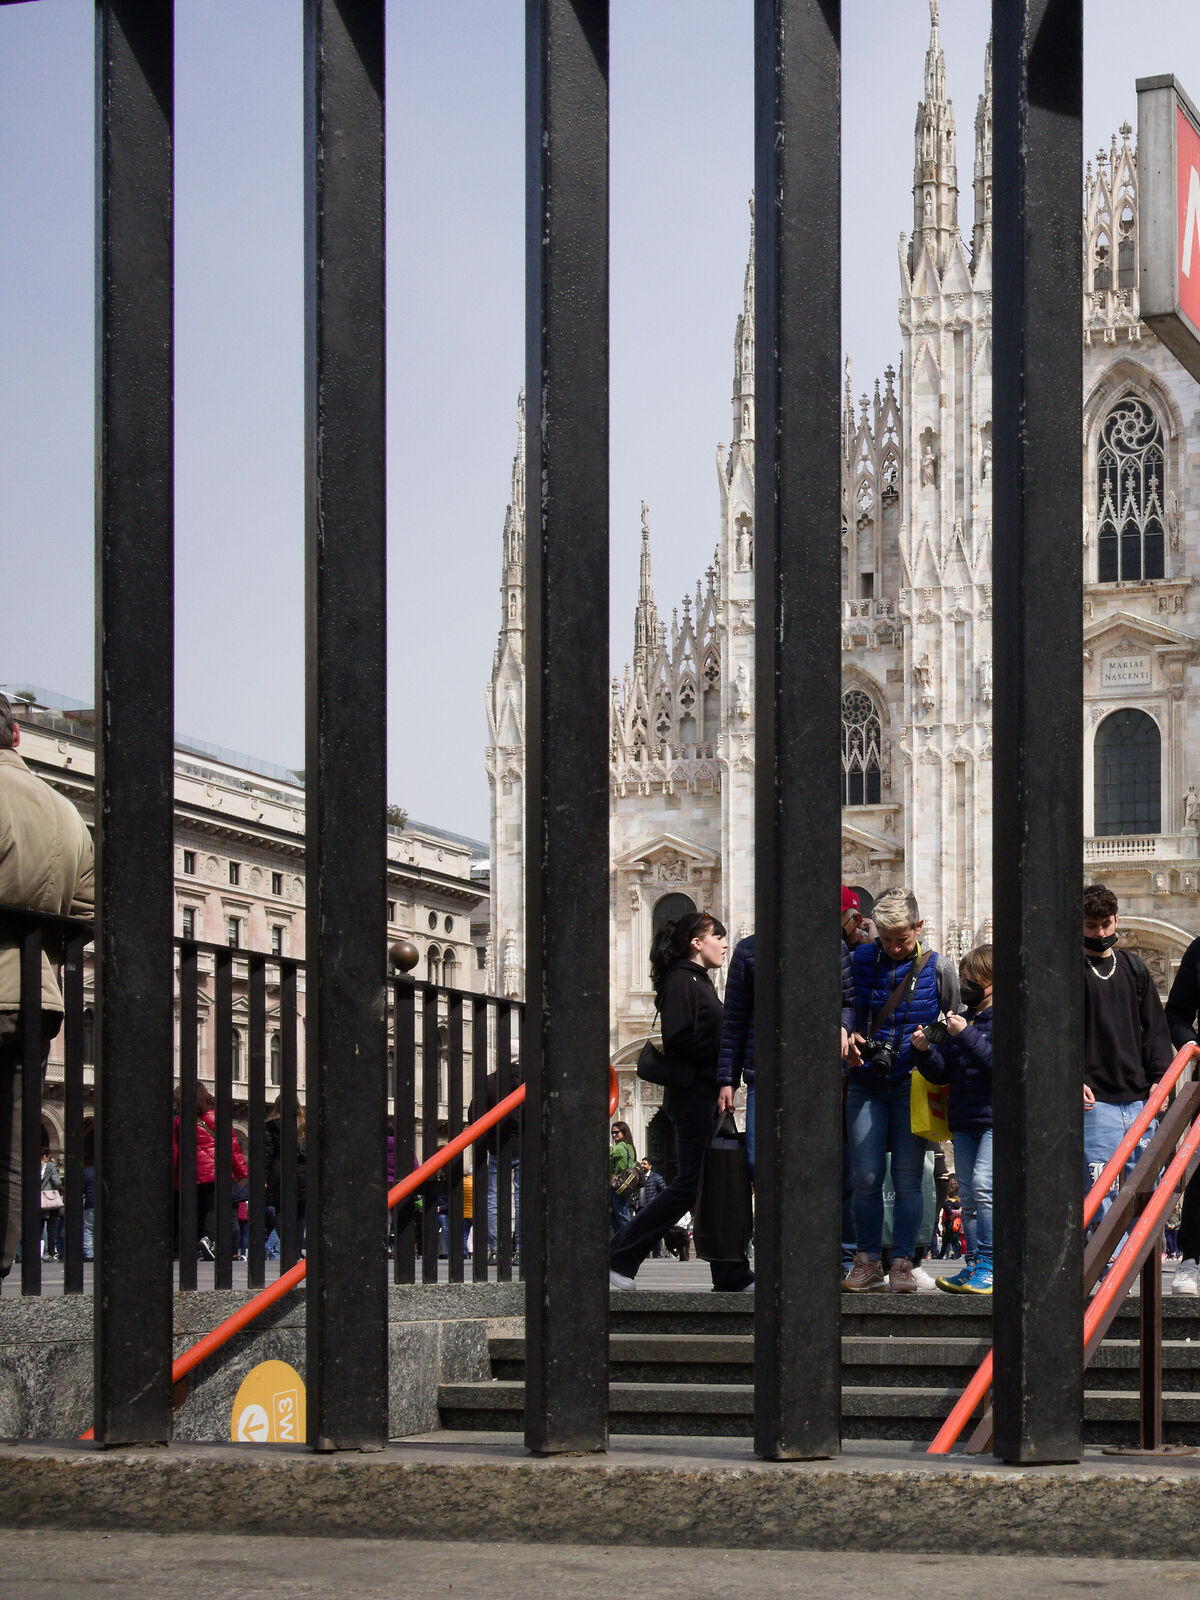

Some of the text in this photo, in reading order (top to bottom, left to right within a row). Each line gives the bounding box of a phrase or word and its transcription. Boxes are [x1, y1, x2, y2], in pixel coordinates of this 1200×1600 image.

[1109, 660, 1145, 669] MARIAE
[1105, 671, 1149, 681] NASCENTI
[279, 1397, 295, 1440] M3
